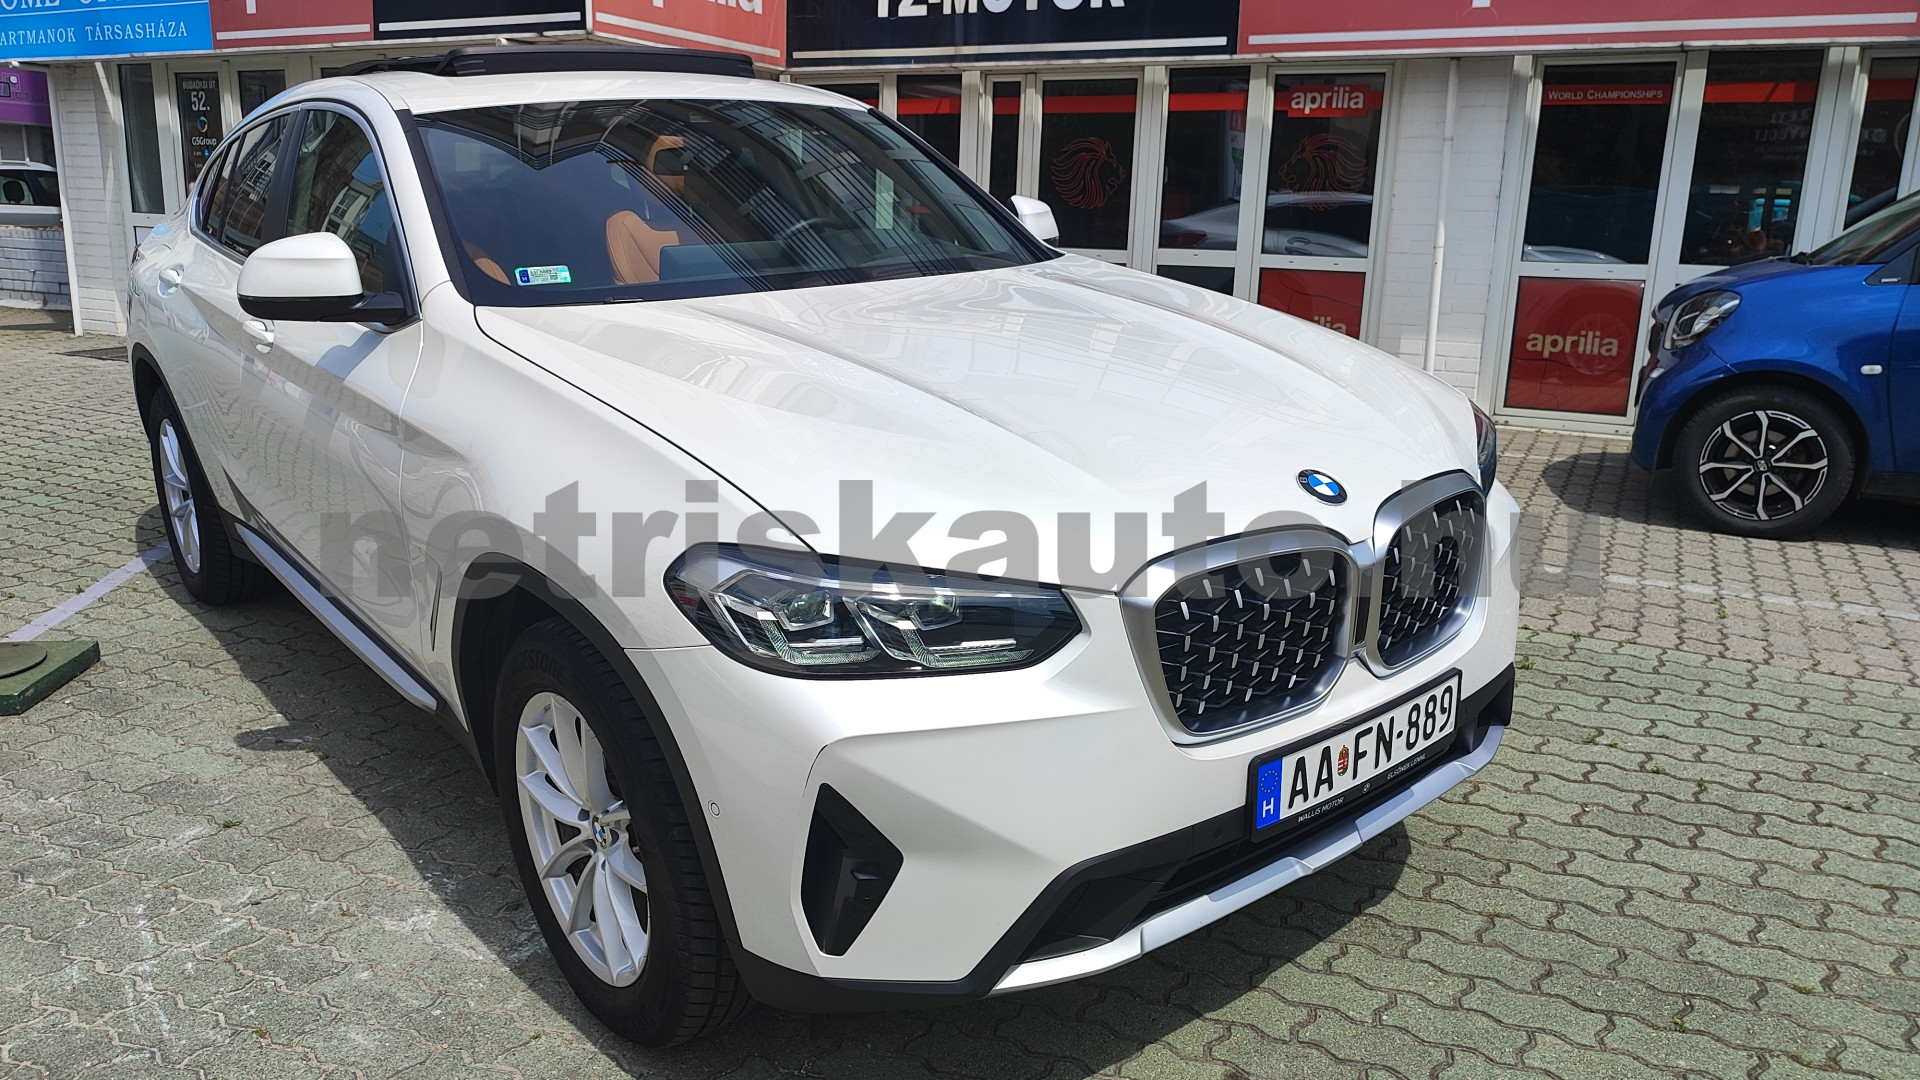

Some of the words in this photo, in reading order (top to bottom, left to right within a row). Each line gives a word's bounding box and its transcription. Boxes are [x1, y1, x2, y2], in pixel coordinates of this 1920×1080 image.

[0, 27, 76, 46] ARTMANOK
[85, 19, 188, 42] TÁRSASHÁZA
[1290, 86, 1364, 115] aprilia
[191, 136, 217, 146] GSGroup
[1525, 330, 1619, 359] aprilia
[1288, 745, 1334, 809] AA
[1262, 797, 1274, 818] H
